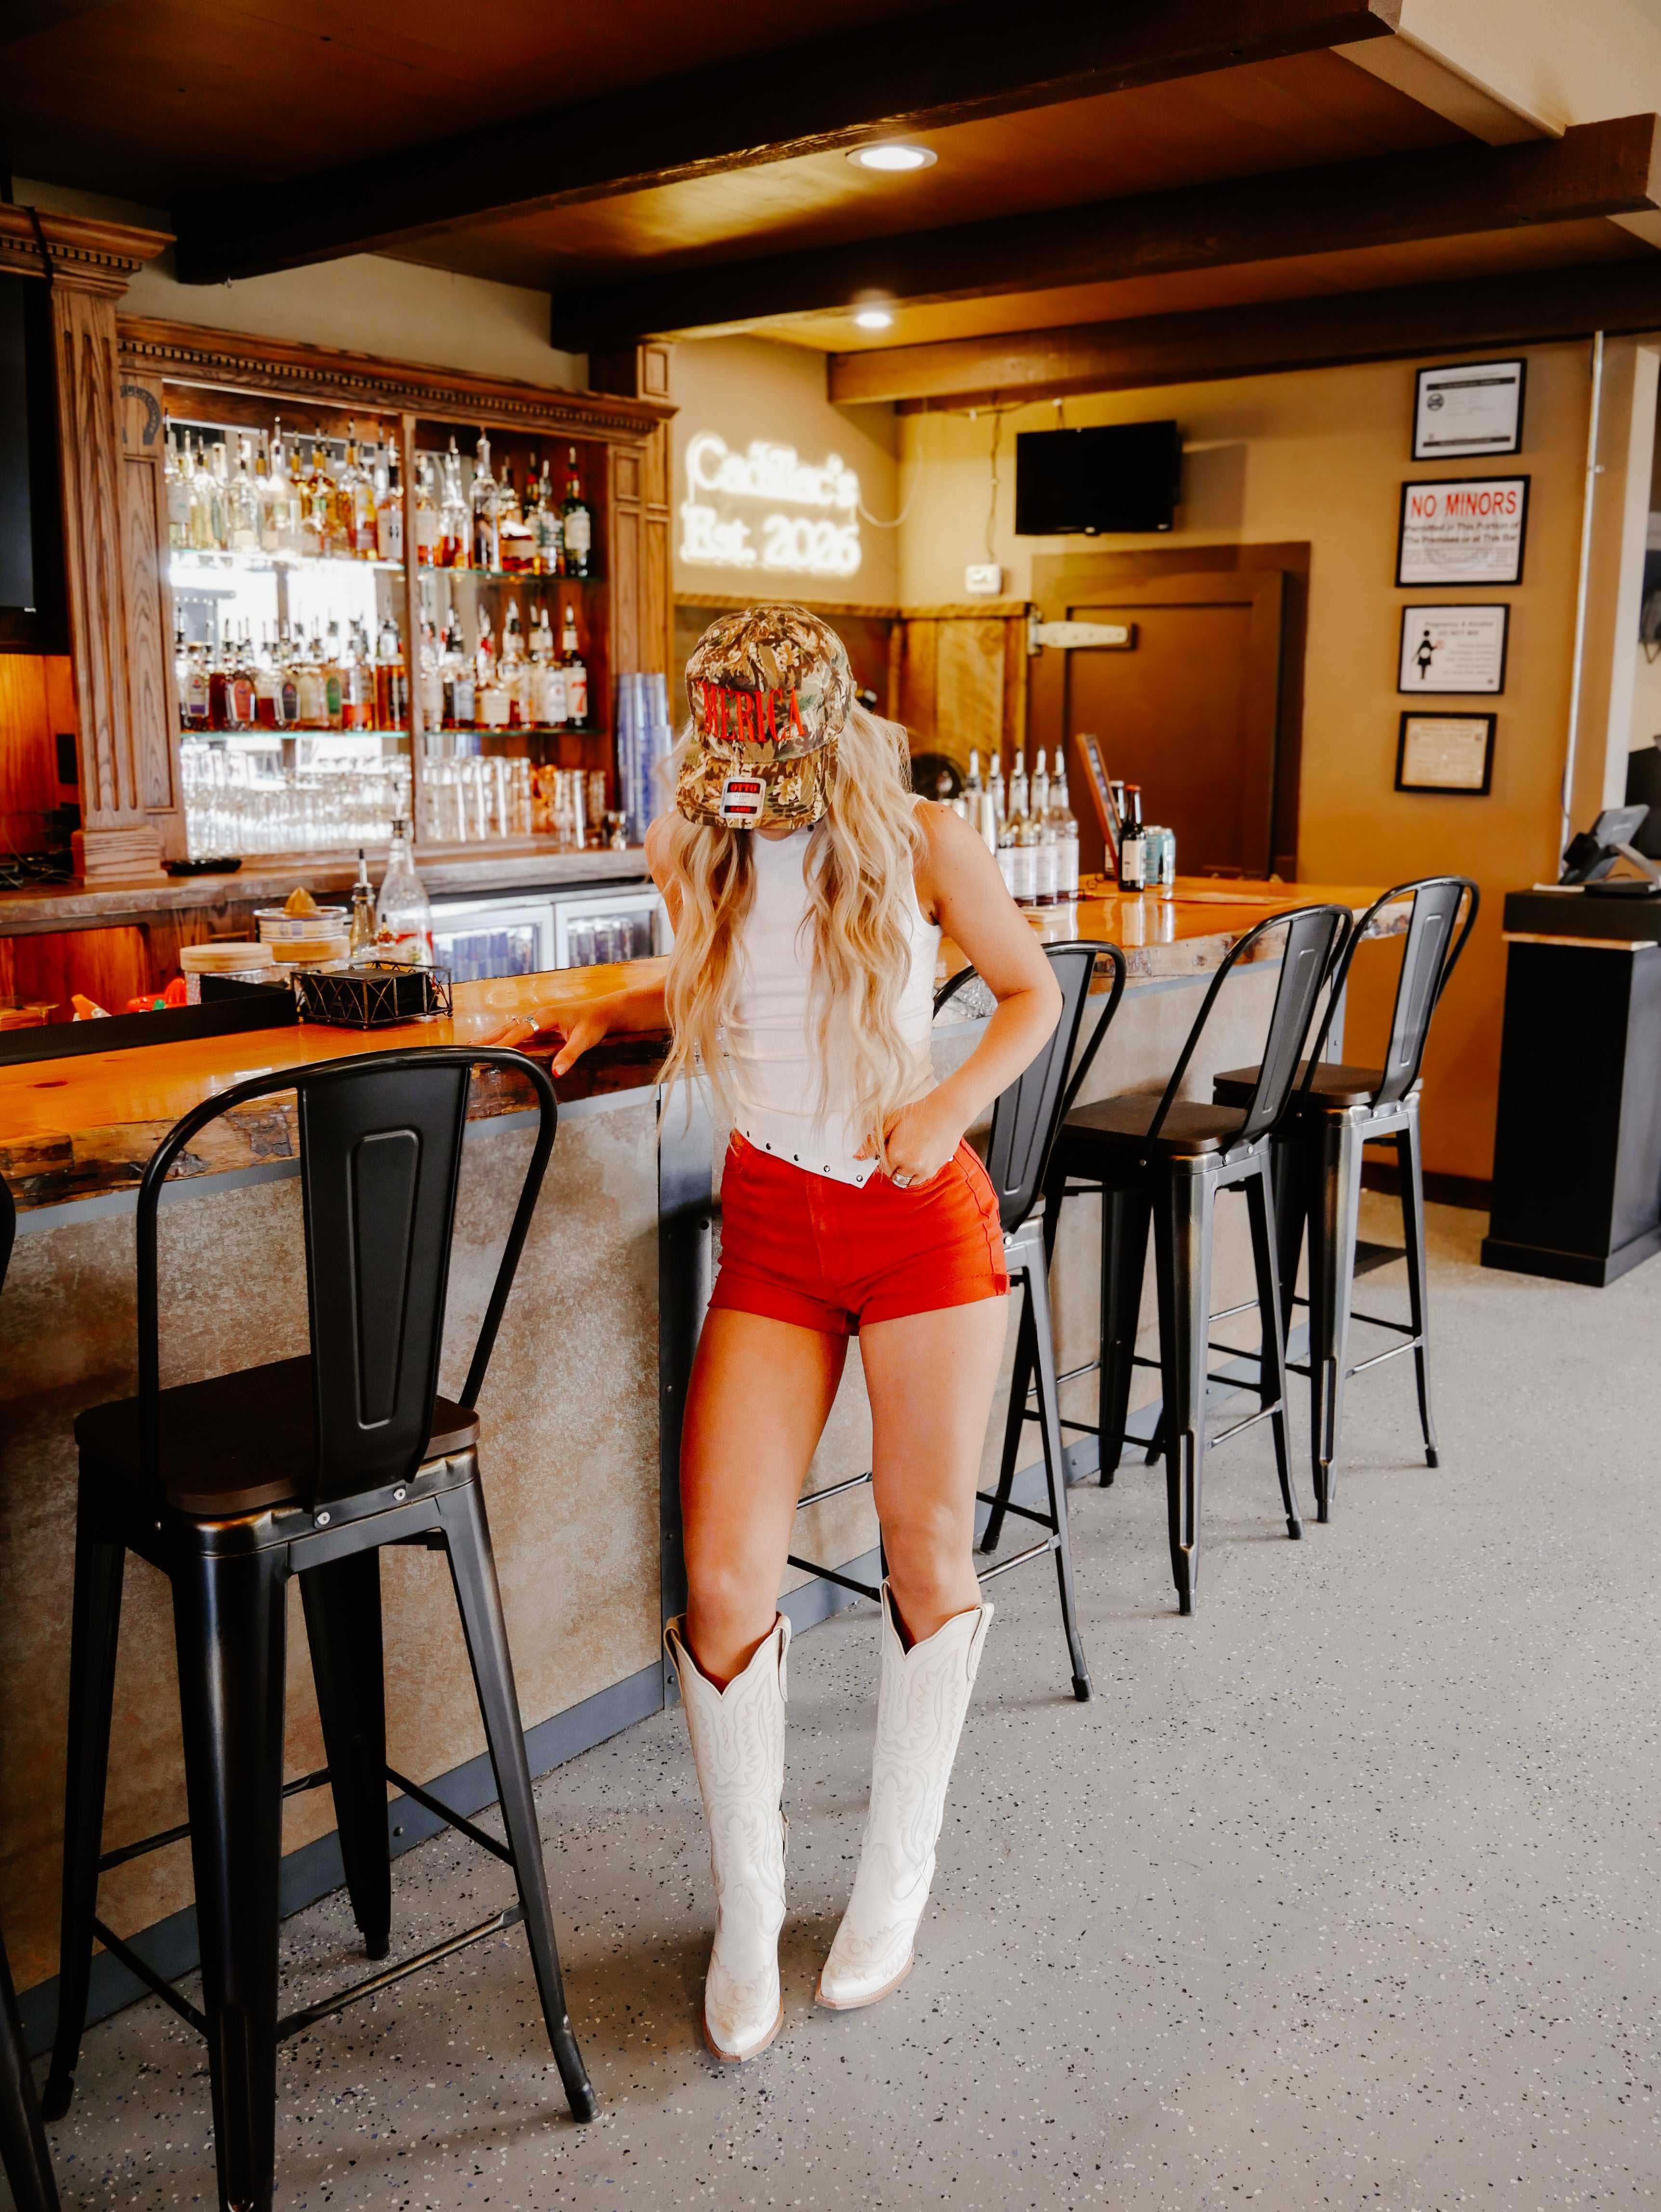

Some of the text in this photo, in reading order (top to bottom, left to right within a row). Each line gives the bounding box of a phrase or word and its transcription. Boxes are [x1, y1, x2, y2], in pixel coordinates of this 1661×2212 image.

[1411, 490, 1517, 518] NO MINORS
[730, 783, 758, 792] OTTO
